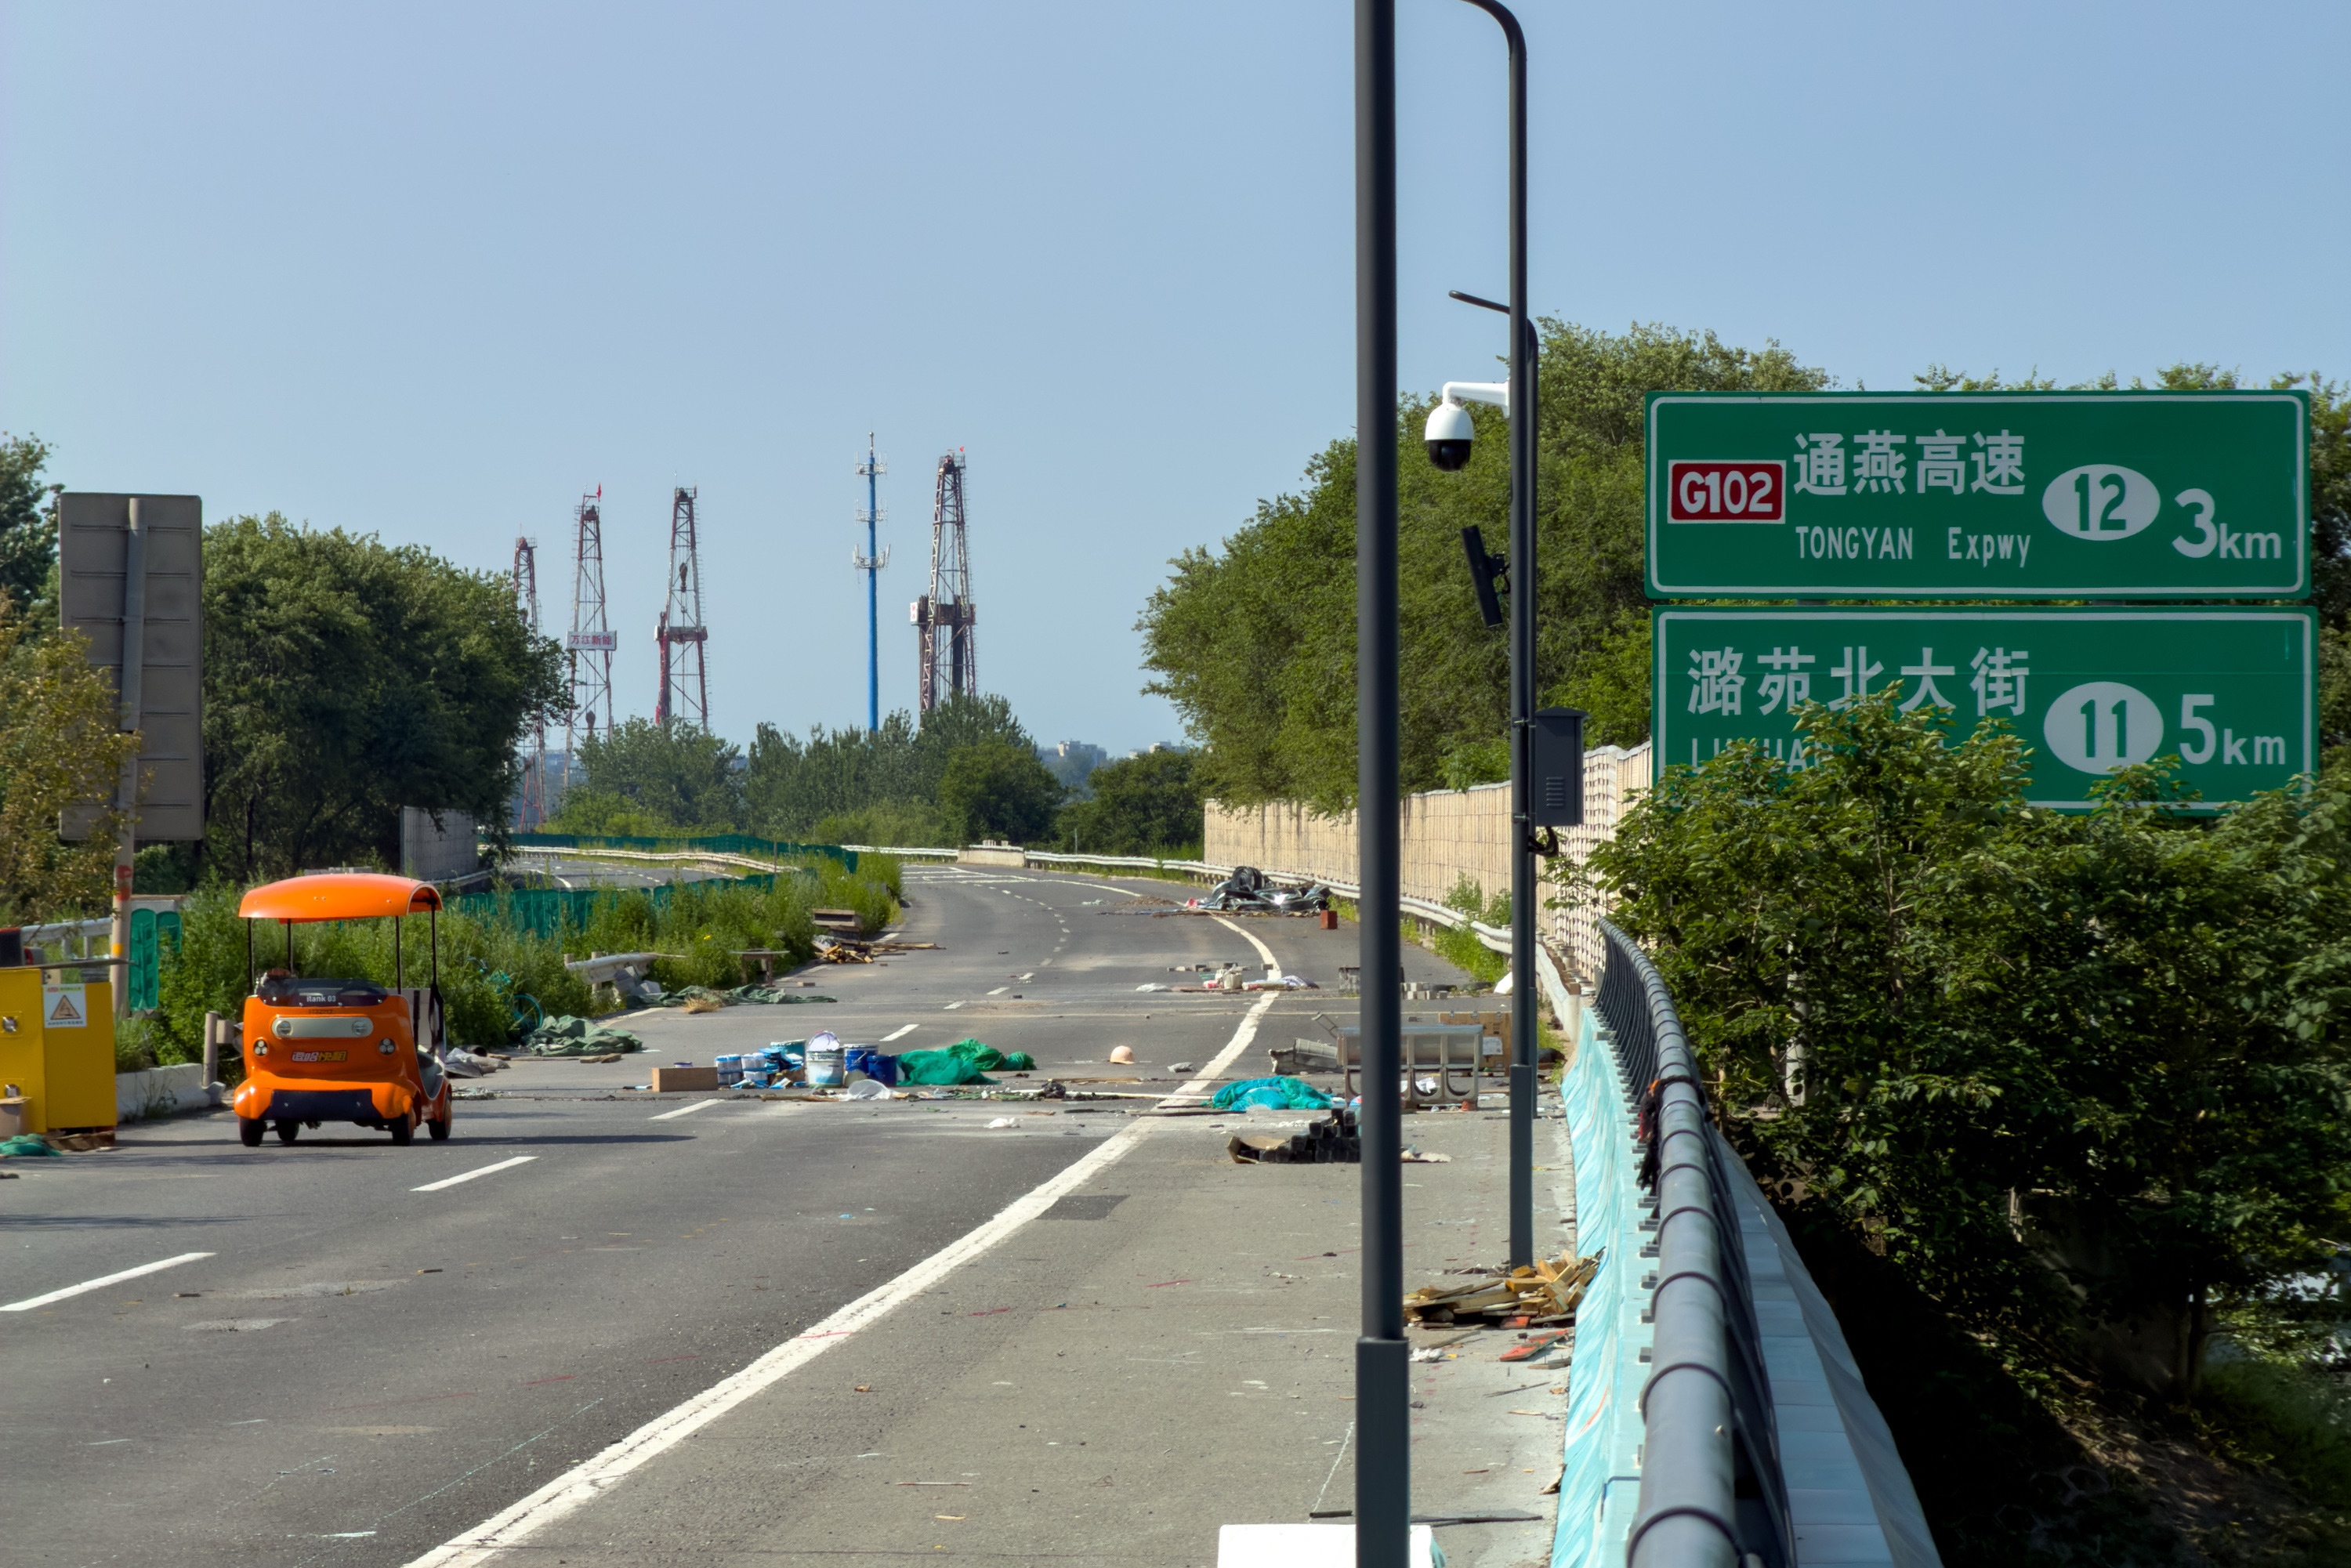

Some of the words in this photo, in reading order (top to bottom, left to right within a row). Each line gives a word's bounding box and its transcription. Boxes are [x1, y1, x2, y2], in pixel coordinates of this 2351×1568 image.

[1793, 429, 2025, 495] 通燕高速
[1679, 470, 1773, 514] G102
[2074, 473, 2128, 532] 12
[1795, 526, 1913, 559] TONGYAN
[1948, 527, 2030, 567] Expwy
[2172, 488, 2281, 559] 3km
[571, 635, 611, 645] 万江新能
[1687, 646, 2030, 716] 潞苑北大街
[2080, 699, 2128, 759] 11
